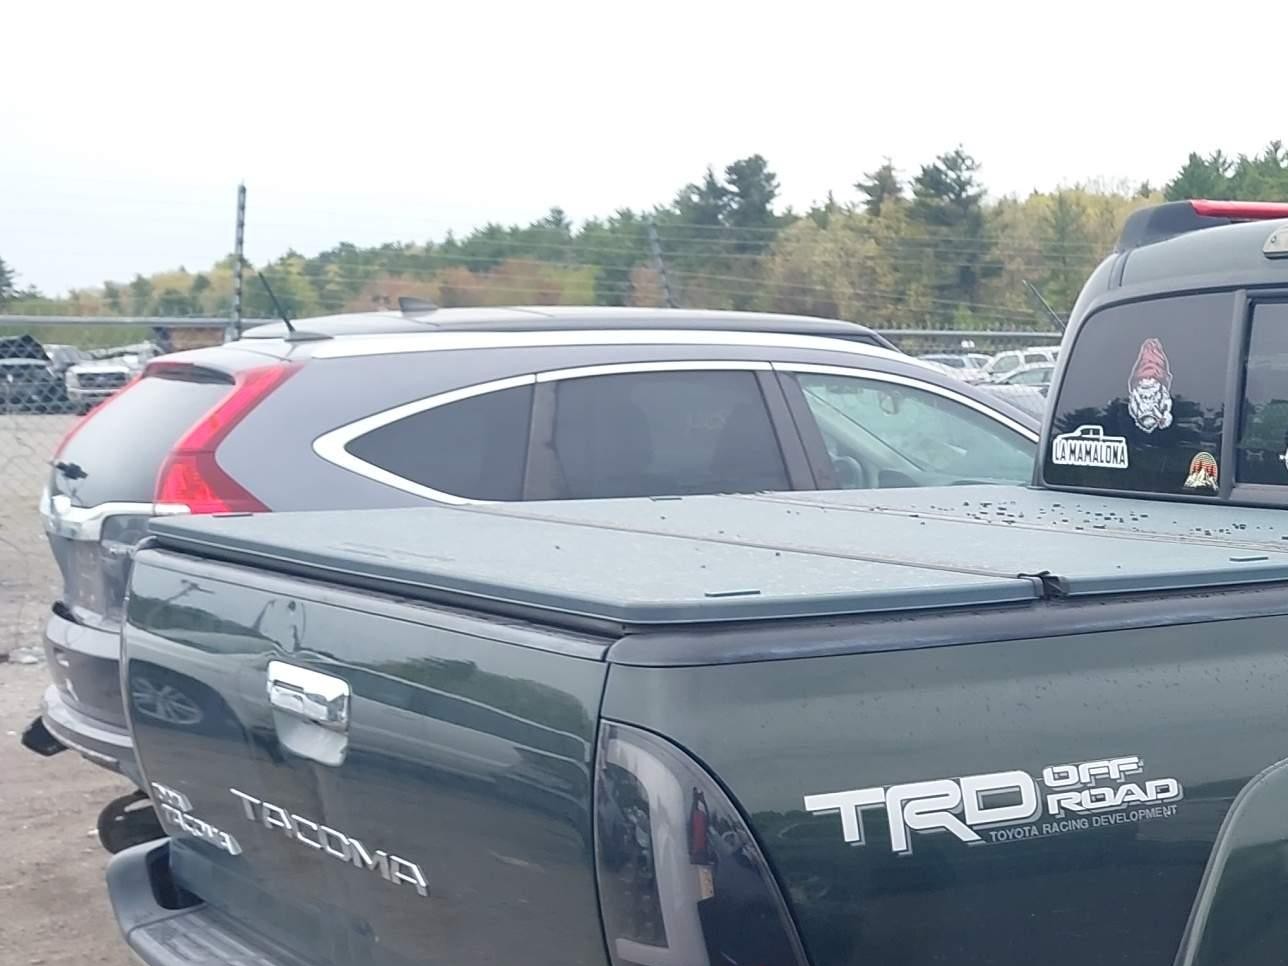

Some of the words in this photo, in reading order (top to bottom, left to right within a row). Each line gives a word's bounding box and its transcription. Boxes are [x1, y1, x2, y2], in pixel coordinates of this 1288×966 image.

[1042, 756, 1143, 789] OFF
[803, 769, 1042, 854] TRD
[1046, 777, 1182, 816] ROAD
[230, 788, 428, 896] TACOMA
[989, 826, 1040, 842] TOYOTA
[1042, 818, 1089, 834] RACING
[1092, 805, 1178, 827] DEVELOPMENT
